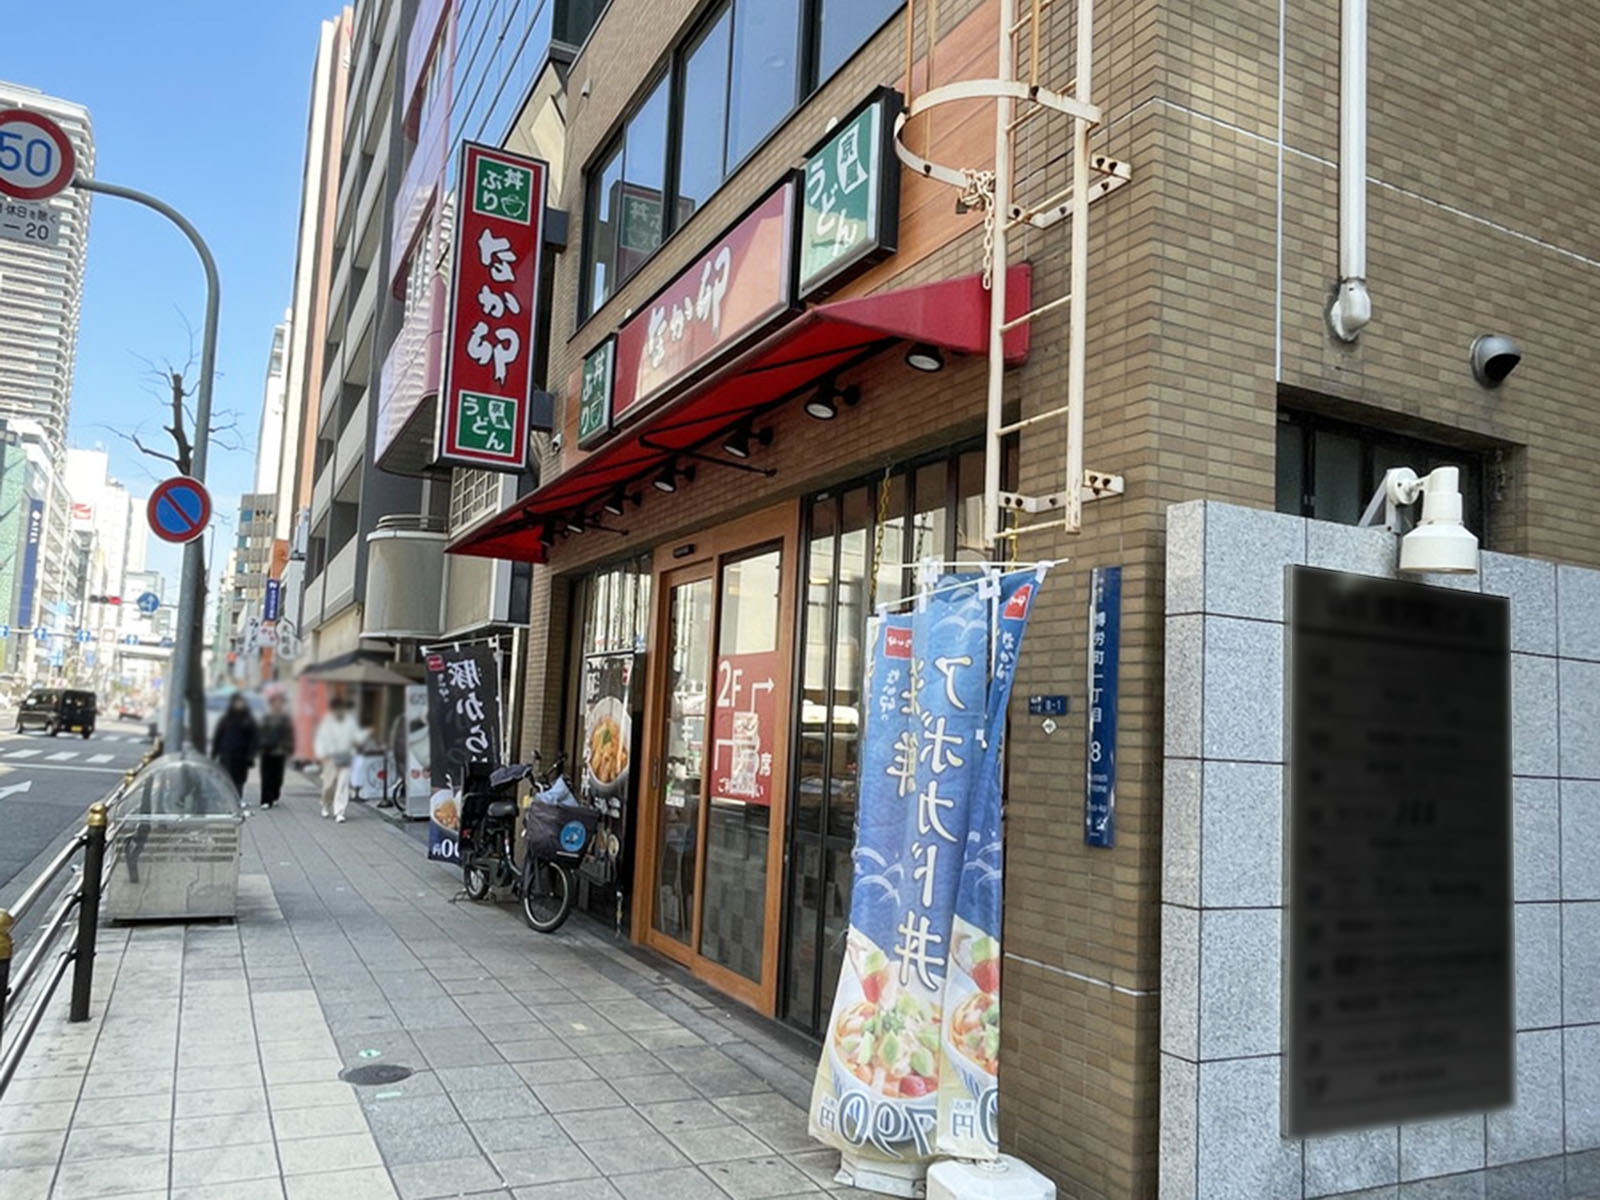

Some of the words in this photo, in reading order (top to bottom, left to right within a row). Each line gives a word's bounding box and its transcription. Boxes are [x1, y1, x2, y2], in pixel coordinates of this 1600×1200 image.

[0, 131, 52, 177] 50
[808, 158, 858, 257] うどん
[467, 228, 521, 386] なか卯
[647, 246, 731, 369] なか卯
[463, 396, 506, 451] うどん
[716, 660, 743, 708] 2F
